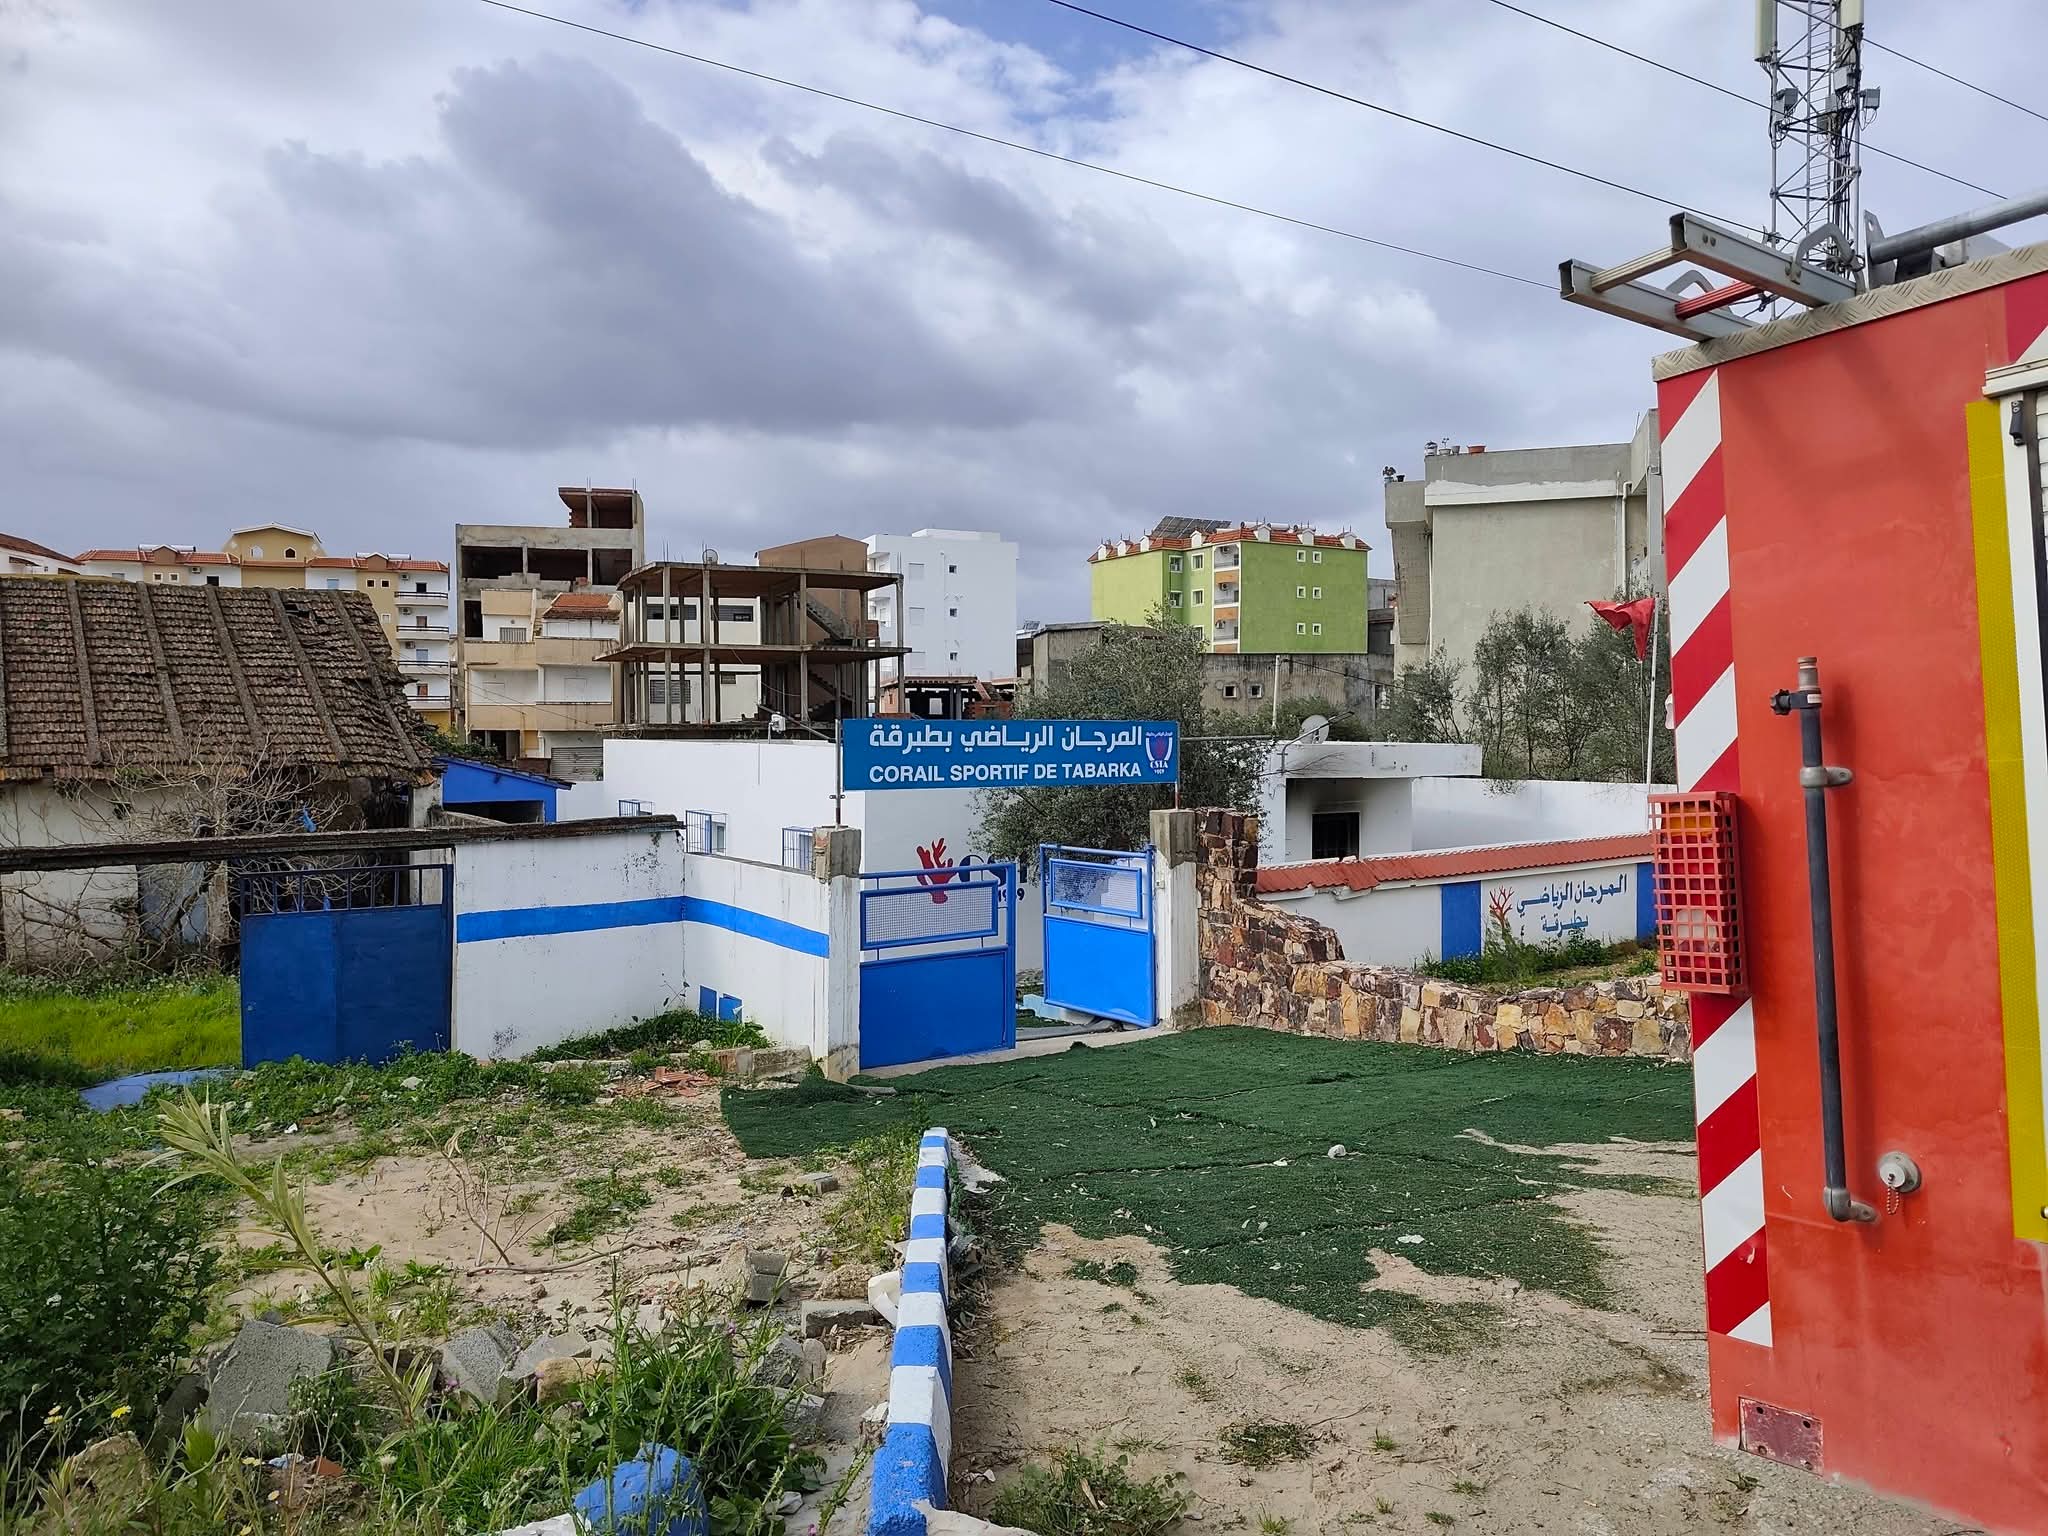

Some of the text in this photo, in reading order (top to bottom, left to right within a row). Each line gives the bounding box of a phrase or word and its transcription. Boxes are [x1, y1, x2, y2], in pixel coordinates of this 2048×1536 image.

[869, 724, 1142, 755] المرجان الرياضي بطبرقة
[869, 762, 1142, 783] CORAIL SPORTIF DE TABARKA
[1516, 873, 1628, 918] المرجان الرياضي
